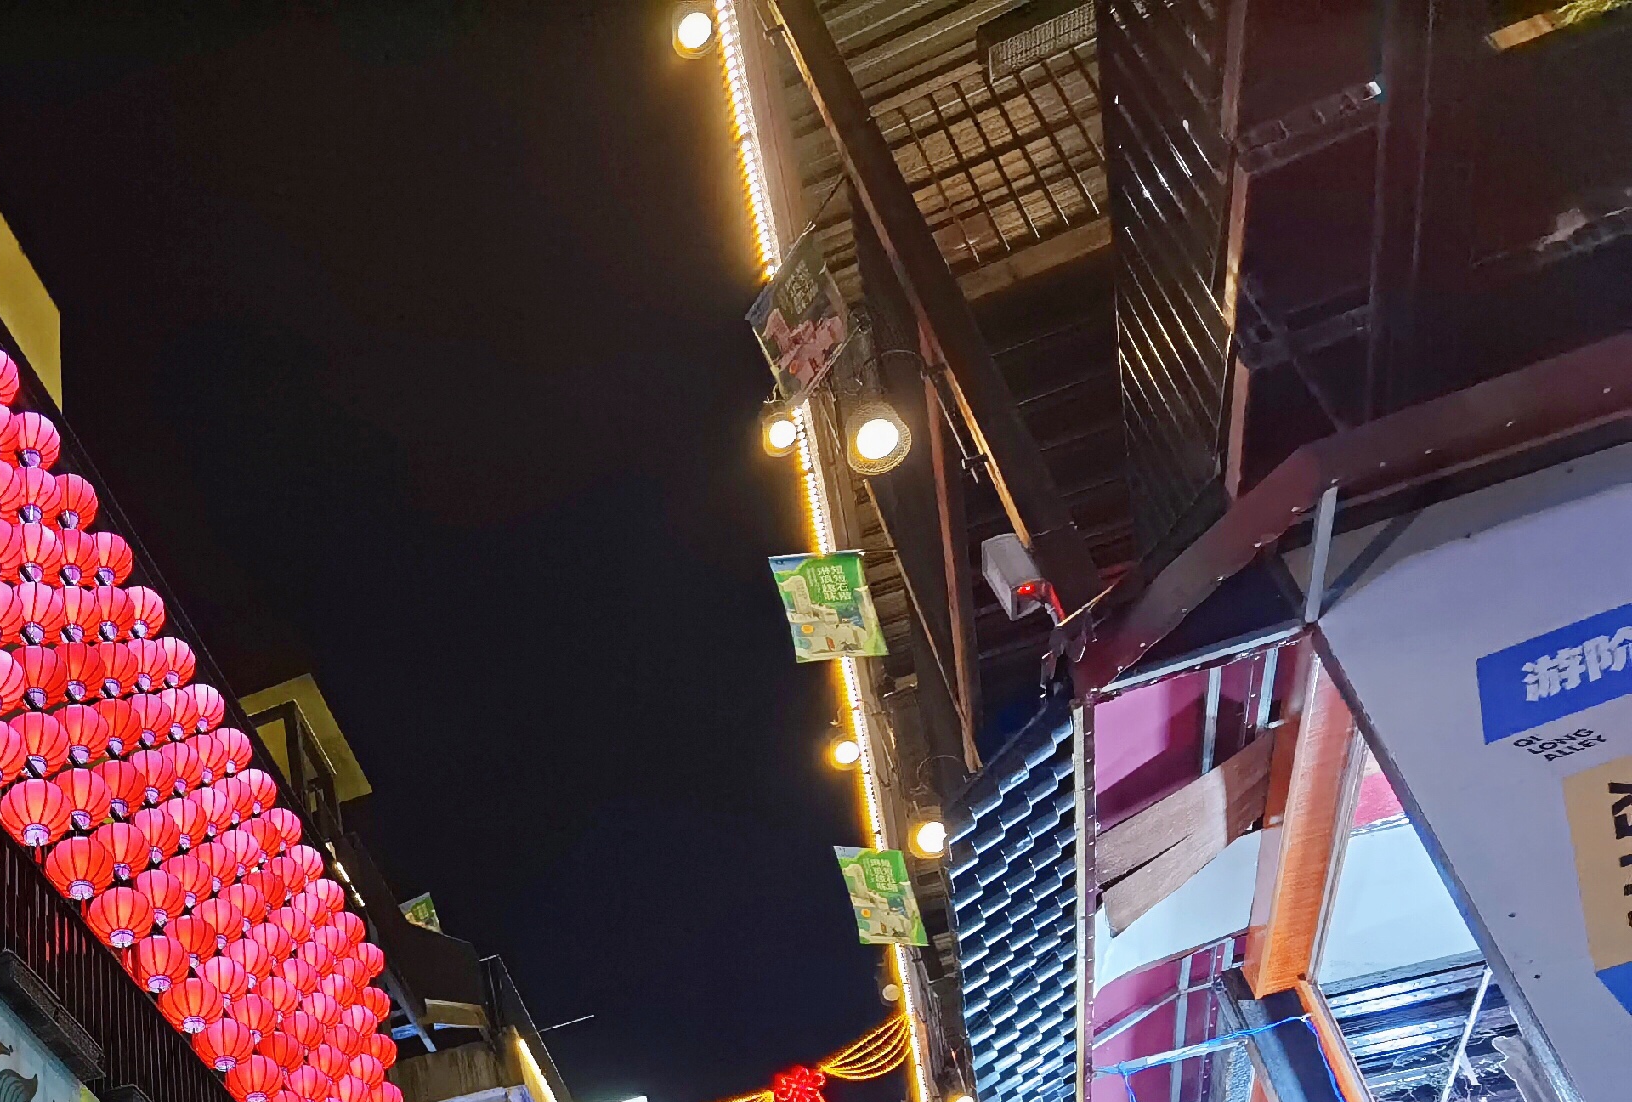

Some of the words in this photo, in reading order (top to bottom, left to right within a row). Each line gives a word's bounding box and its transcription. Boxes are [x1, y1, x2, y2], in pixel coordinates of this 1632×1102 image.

[1513, 733, 1544, 748] QI
[1527, 728, 1594, 755] LONG
[1543, 734, 1608, 762] ALLEY
